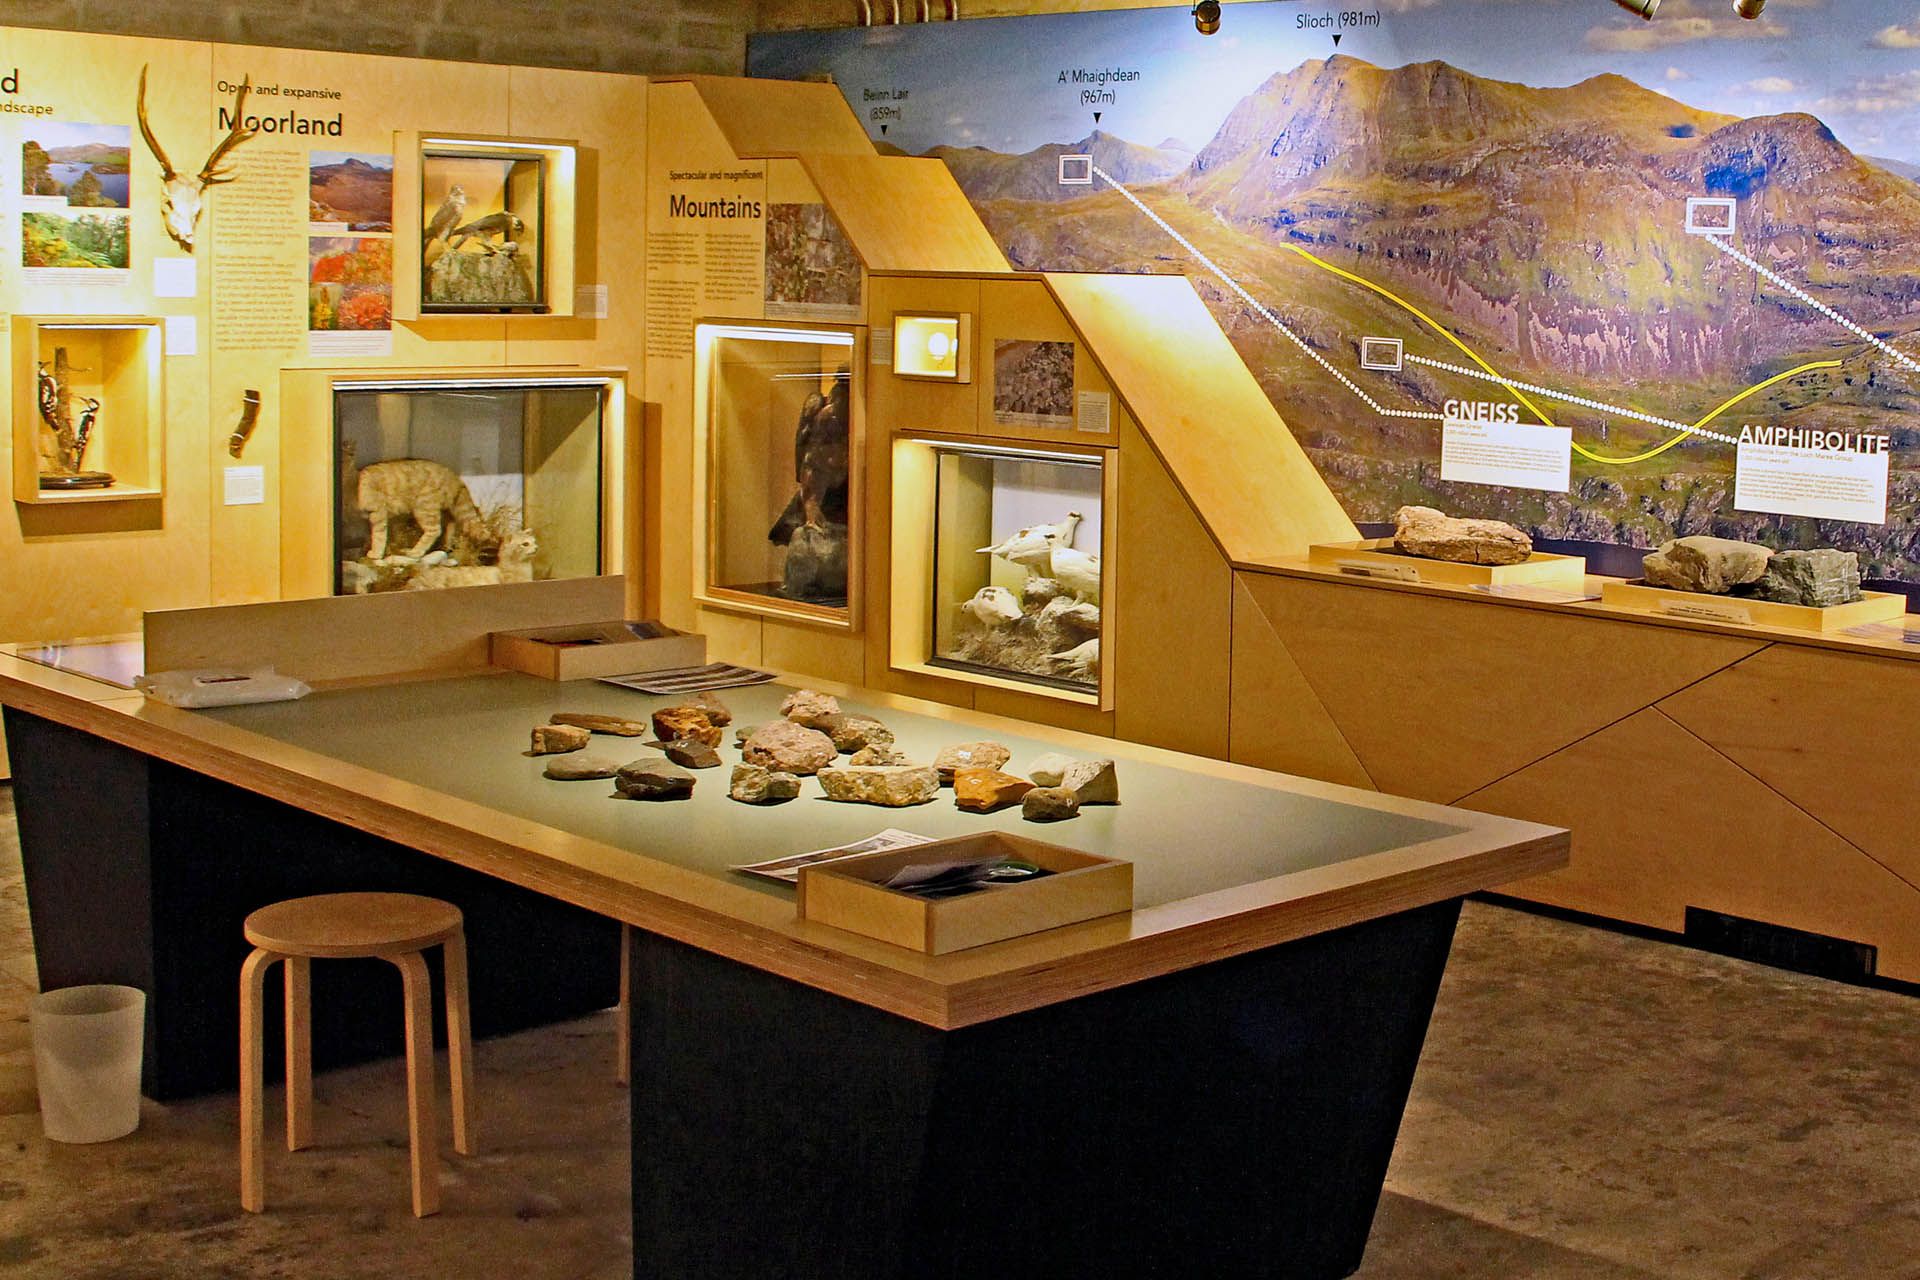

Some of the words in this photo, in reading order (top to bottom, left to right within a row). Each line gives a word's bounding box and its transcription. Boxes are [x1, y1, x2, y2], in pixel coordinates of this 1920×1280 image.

[1296, 11, 1334, 29] Slioch
[1338, 10, 1380, 29] (981m)
[1072, 67, 1140, 86] Mhaighdean
[256, 83, 279, 96] and
[283, 87, 342, 100] expansive
[1080, 89, 1116, 106] (967m)
[218, 106, 343, 136] Moorland
[670, 170, 707, 182] Spectacular
[709, 170, 722, 180] and
[723, 169, 763, 182] magnificent
[670, 194, 761, 218] Mountains
[1443, 399, 1519, 424] GNEISS
[1739, 424, 1890, 455] AMPHIBOLITE
